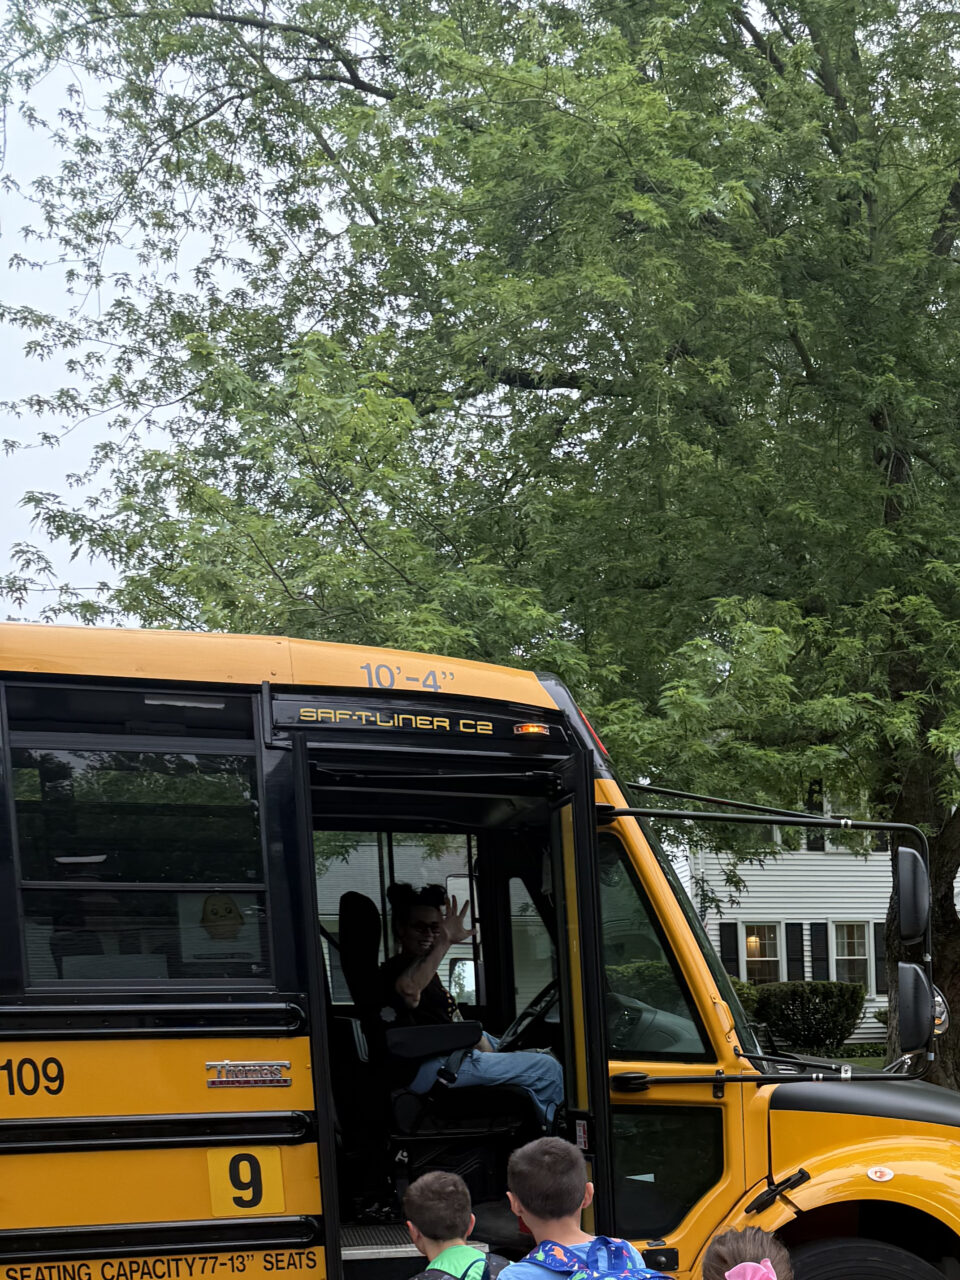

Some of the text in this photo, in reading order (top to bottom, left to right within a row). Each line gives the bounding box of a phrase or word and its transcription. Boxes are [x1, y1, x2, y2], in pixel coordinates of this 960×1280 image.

[300, 708, 493, 734] SAF-T-LINER C2
[0, 1057, 65, 1096] 109
[228, 1153, 263, 1208] 9
[263, 1251, 317, 1271] SEATS
